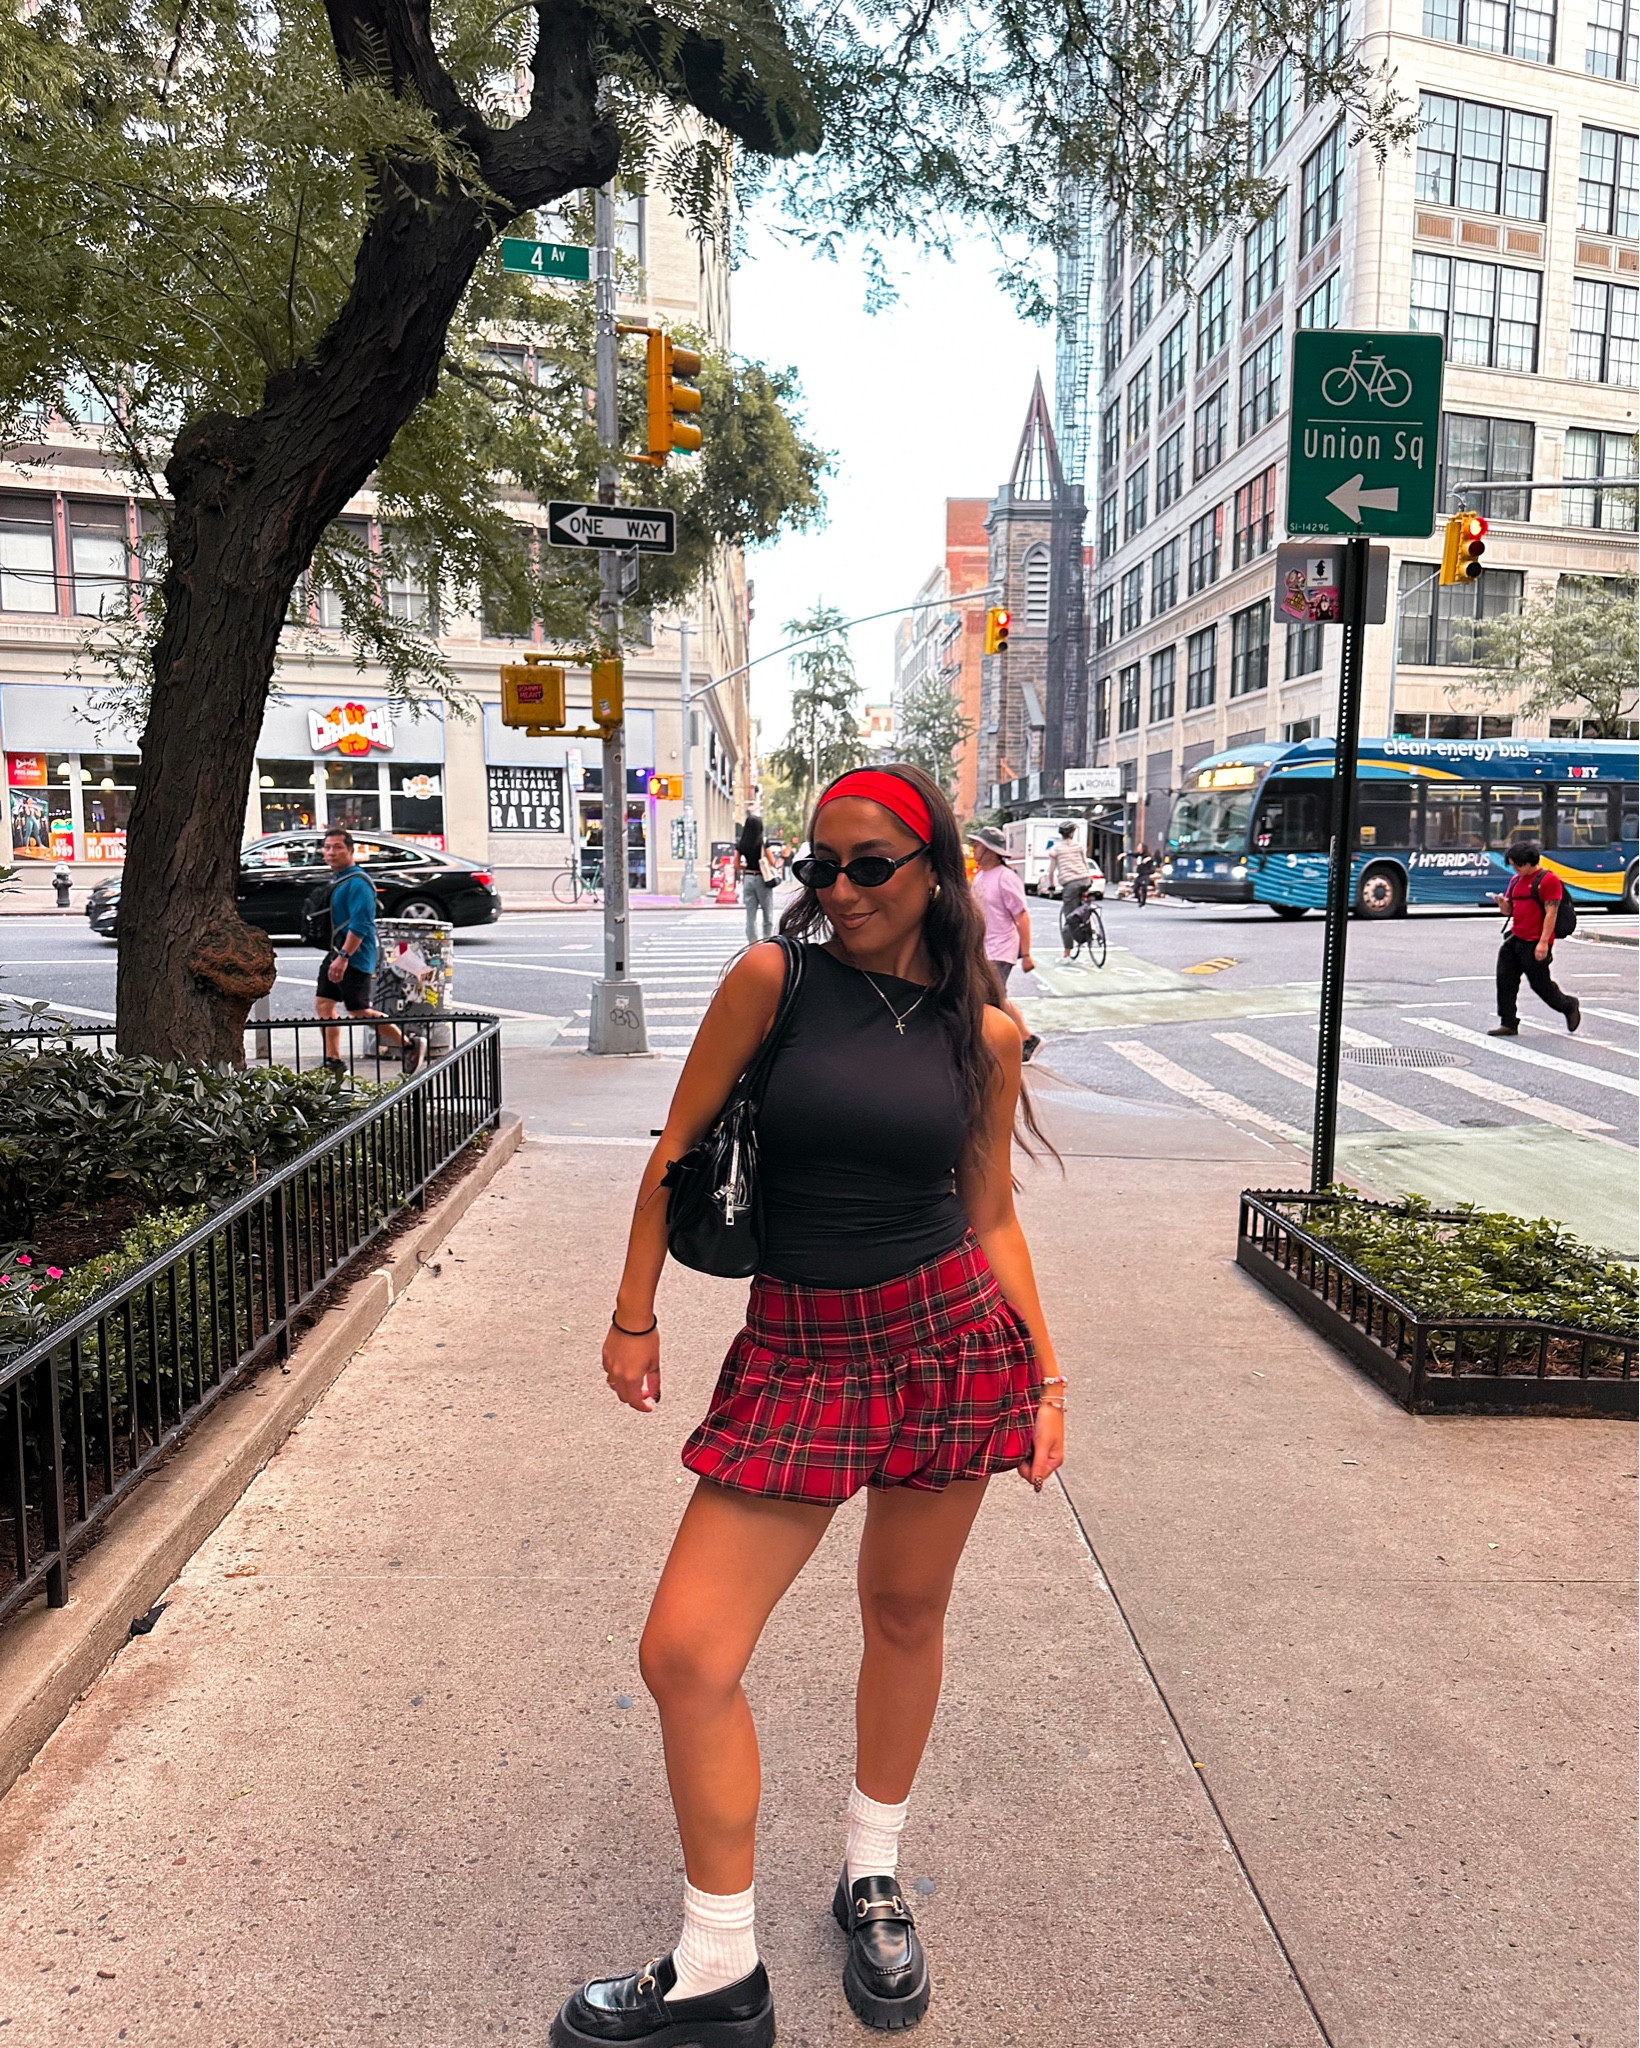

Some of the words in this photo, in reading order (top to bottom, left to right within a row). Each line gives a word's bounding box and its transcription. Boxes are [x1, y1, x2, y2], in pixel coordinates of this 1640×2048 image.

[530, 246, 544, 271] 4
[551, 246, 566, 262] Av
[1304, 426, 1380, 460] Union
[1393, 430, 1424, 470] Sq
[569, 516, 604, 535] ONE
[626, 520, 661, 540] WAY
[308, 704, 394, 751] CRUNCH
[1382, 738, 1495, 761] clean-energy
[1498, 741, 1529, 758] bus
[489, 778, 558, 789] BELIEVABLE
[1086, 779, 1116, 788] ROYAL
[489, 790, 560, 806] STUDENT
[490, 806, 561, 828] RATES
[52, 845, 73, 857] 1989
[87, 846, 103, 859] NO
